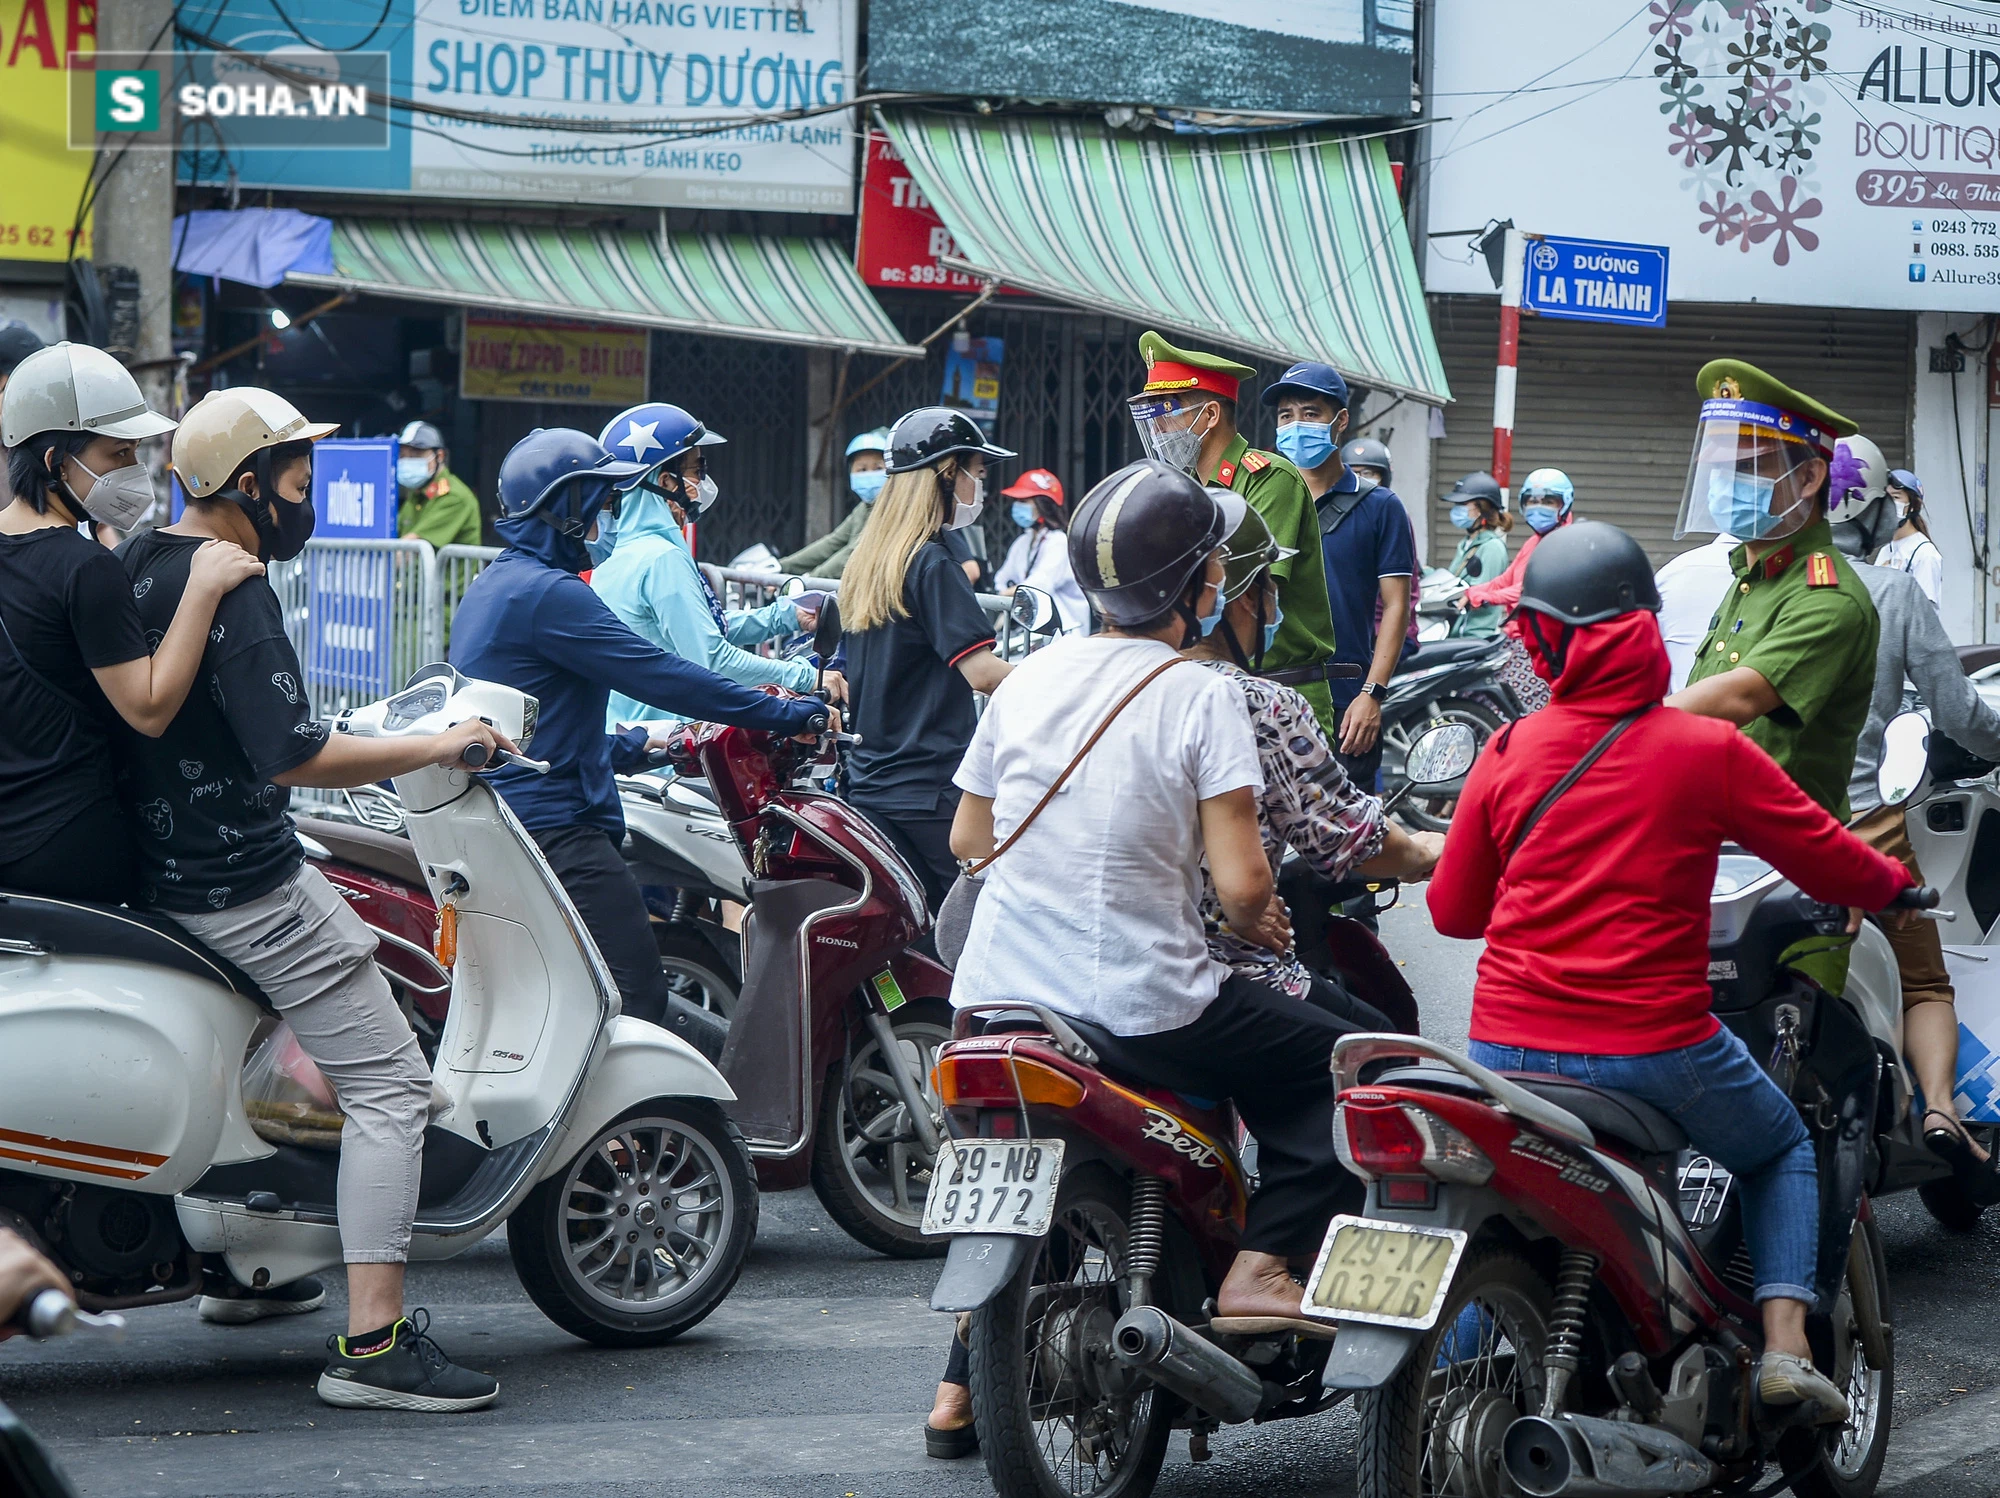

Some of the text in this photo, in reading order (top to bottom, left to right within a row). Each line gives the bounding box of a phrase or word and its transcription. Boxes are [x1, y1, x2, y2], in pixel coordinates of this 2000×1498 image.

[703, 7, 814, 33] VIETTEL
[1941, 15, 1979, 37] duy
[428, 37, 843, 112] SHOP THÙY DƯƠNG
[1855, 121, 2000, 170] BOUTIQ
[644, 146, 698, 169] BÁNH
[703, 151, 742, 176] KẸO
[1862, 174, 1927, 203] 395
[1931, 181, 1959, 200] La
[27, 227, 55, 247] 62
[1931, 219, 1997, 236] 0243 772
[1931, 242, 1969, 257] 0983.
[910, 264, 948, 284] 393
[1573, 252, 1640, 275] ĐƯỜNG
[1538, 274, 1652, 313] LA THÀNH
[816, 936, 859, 949] HONDA
[956, 1040, 1000, 1049] SUZUKI
[1350, 1093, 1386, 1101] HONDA
[1142, 1108, 1224, 1168] Best
[942, 1186, 1033, 1226] 9372
